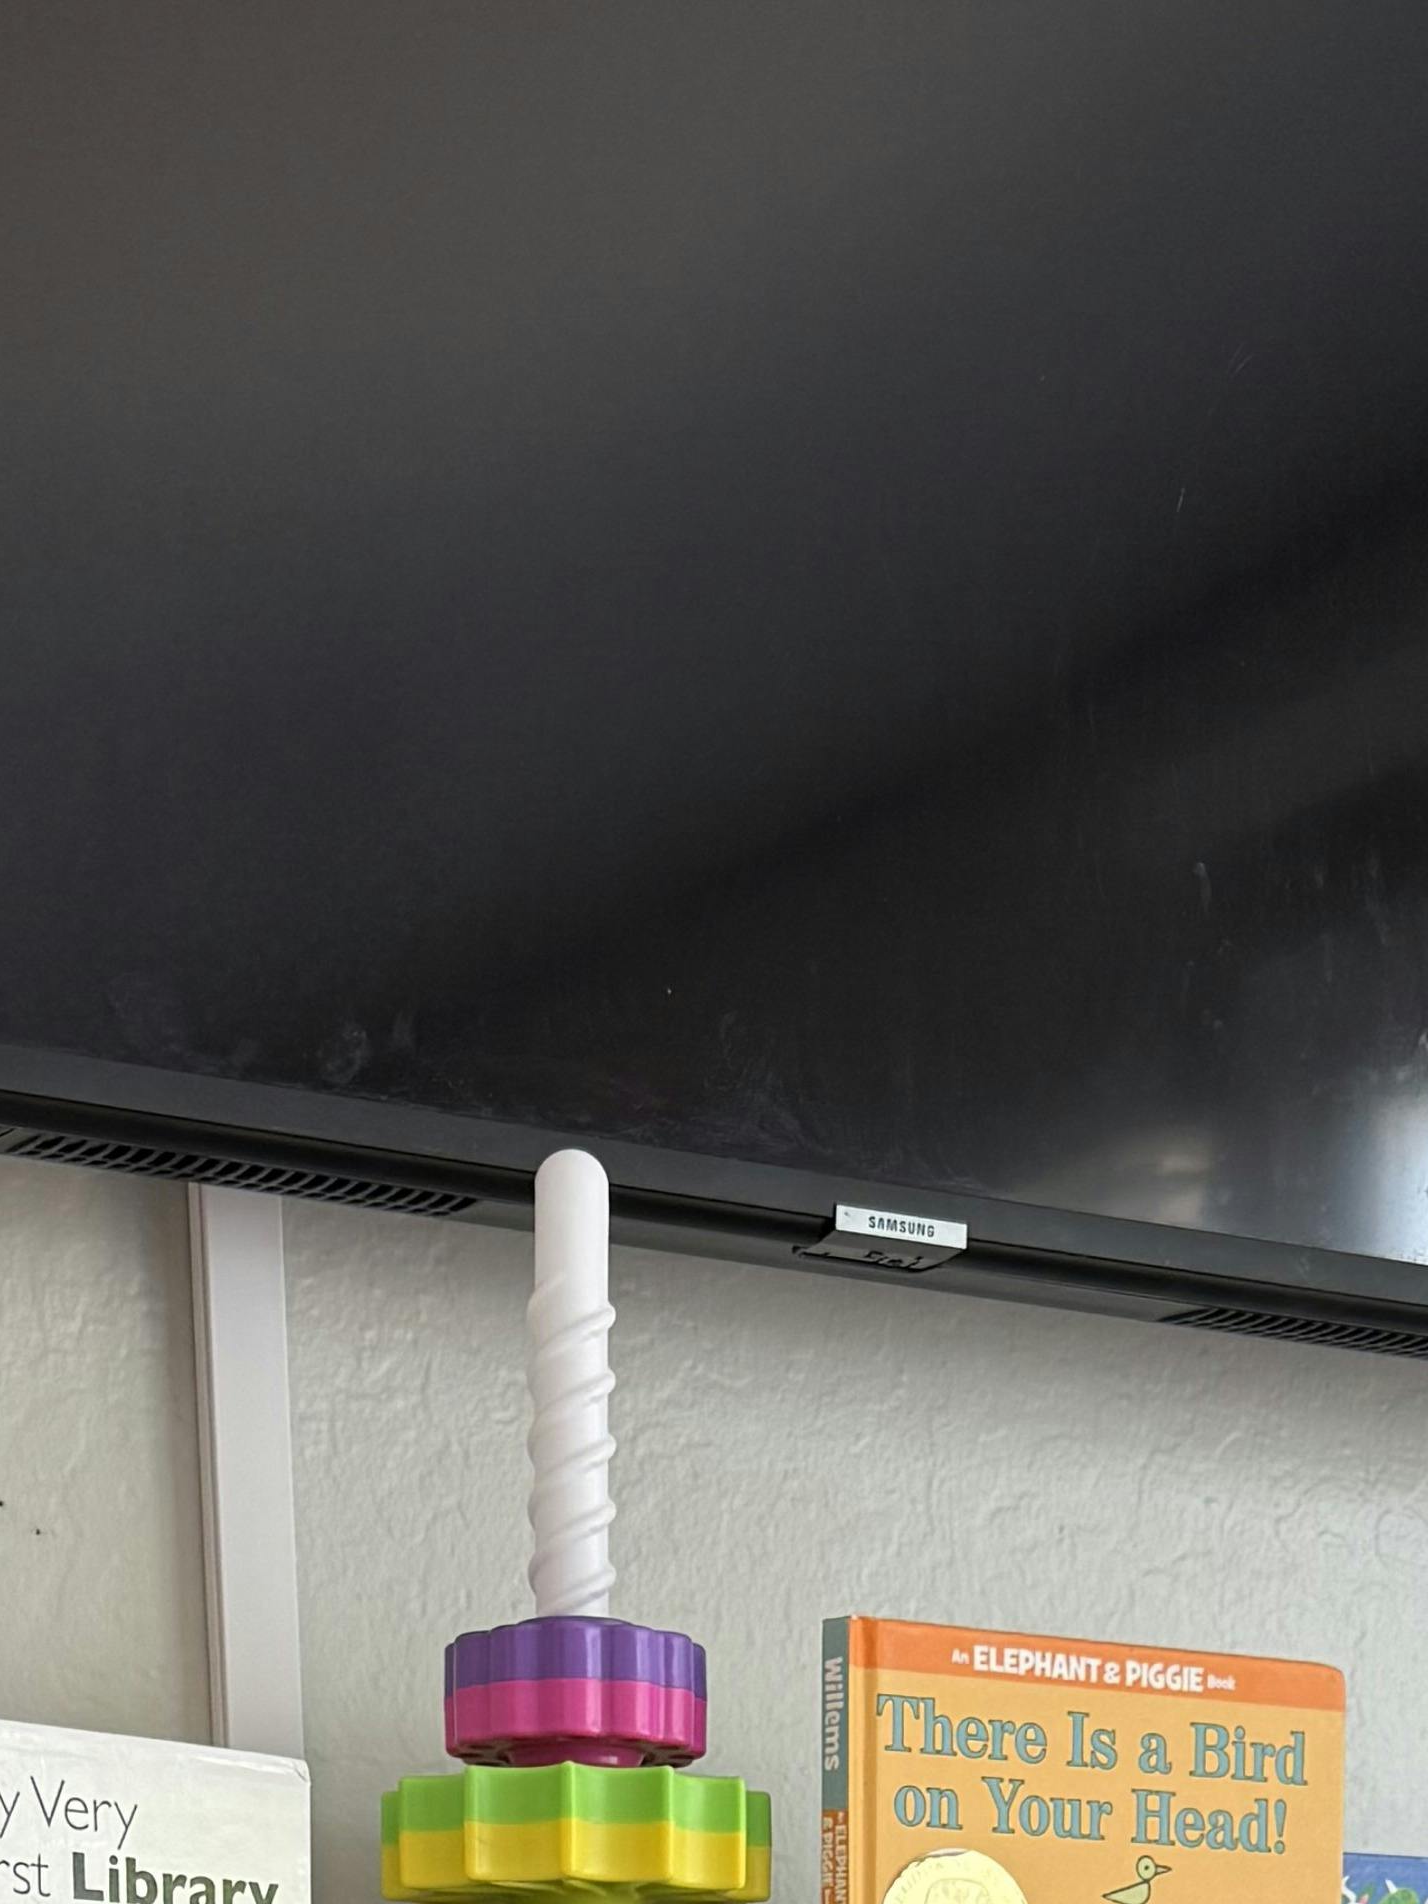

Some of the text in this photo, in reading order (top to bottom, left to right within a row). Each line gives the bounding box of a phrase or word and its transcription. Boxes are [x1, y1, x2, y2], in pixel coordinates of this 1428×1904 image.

[867, 1214, 935, 1238] SAMSUNG
[951, 1644, 1236, 1693] An ELEPHANT & PIGGIE Book
[824, 1655, 845, 1773] Willems
[876, 1693, 1308, 1787] There Is a Bird
[30, 1775, 138, 1850] Very
[893, 1776, 1288, 1855] on Your Head!
